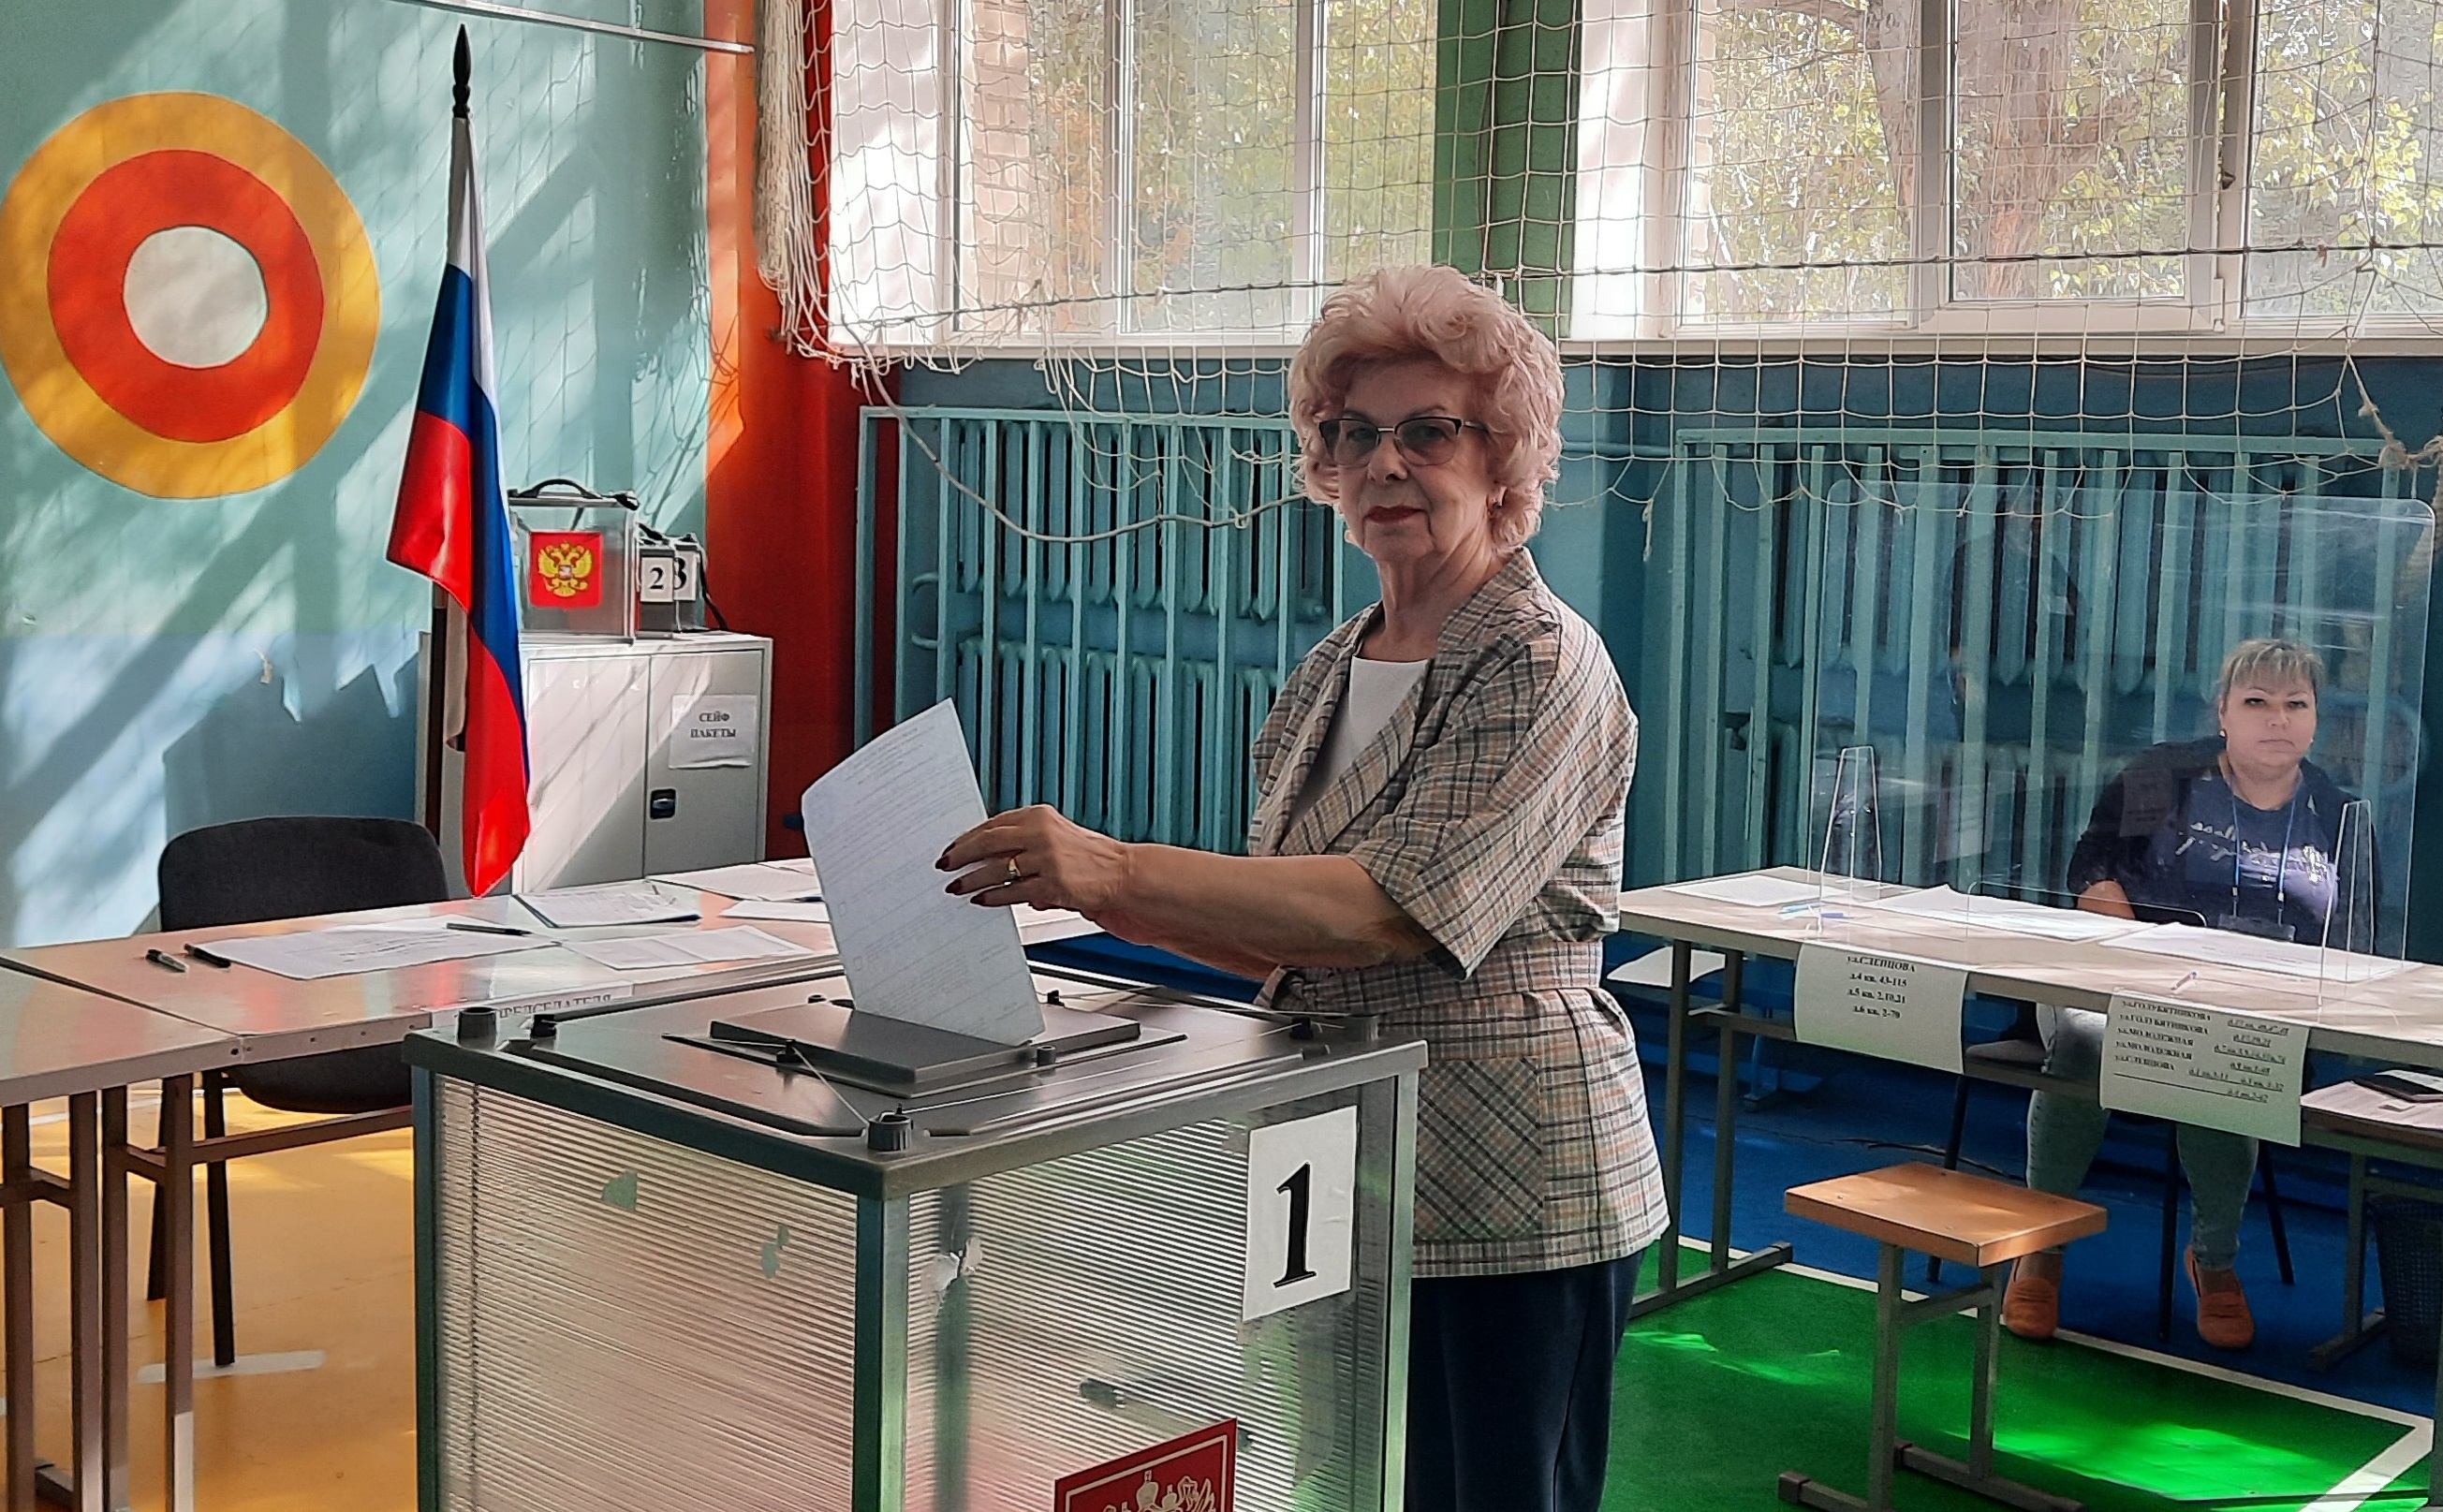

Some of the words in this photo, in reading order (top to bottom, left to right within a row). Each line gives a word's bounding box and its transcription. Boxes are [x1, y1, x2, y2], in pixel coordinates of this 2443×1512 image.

[650, 566, 664, 590] 2
[673, 556, 687, 591] 3
[699, 711, 730, 722] СЕЙФ
[690, 728, 736, 738] ПАКЕТЫ
[1273, 1163, 1317, 1288] 1
